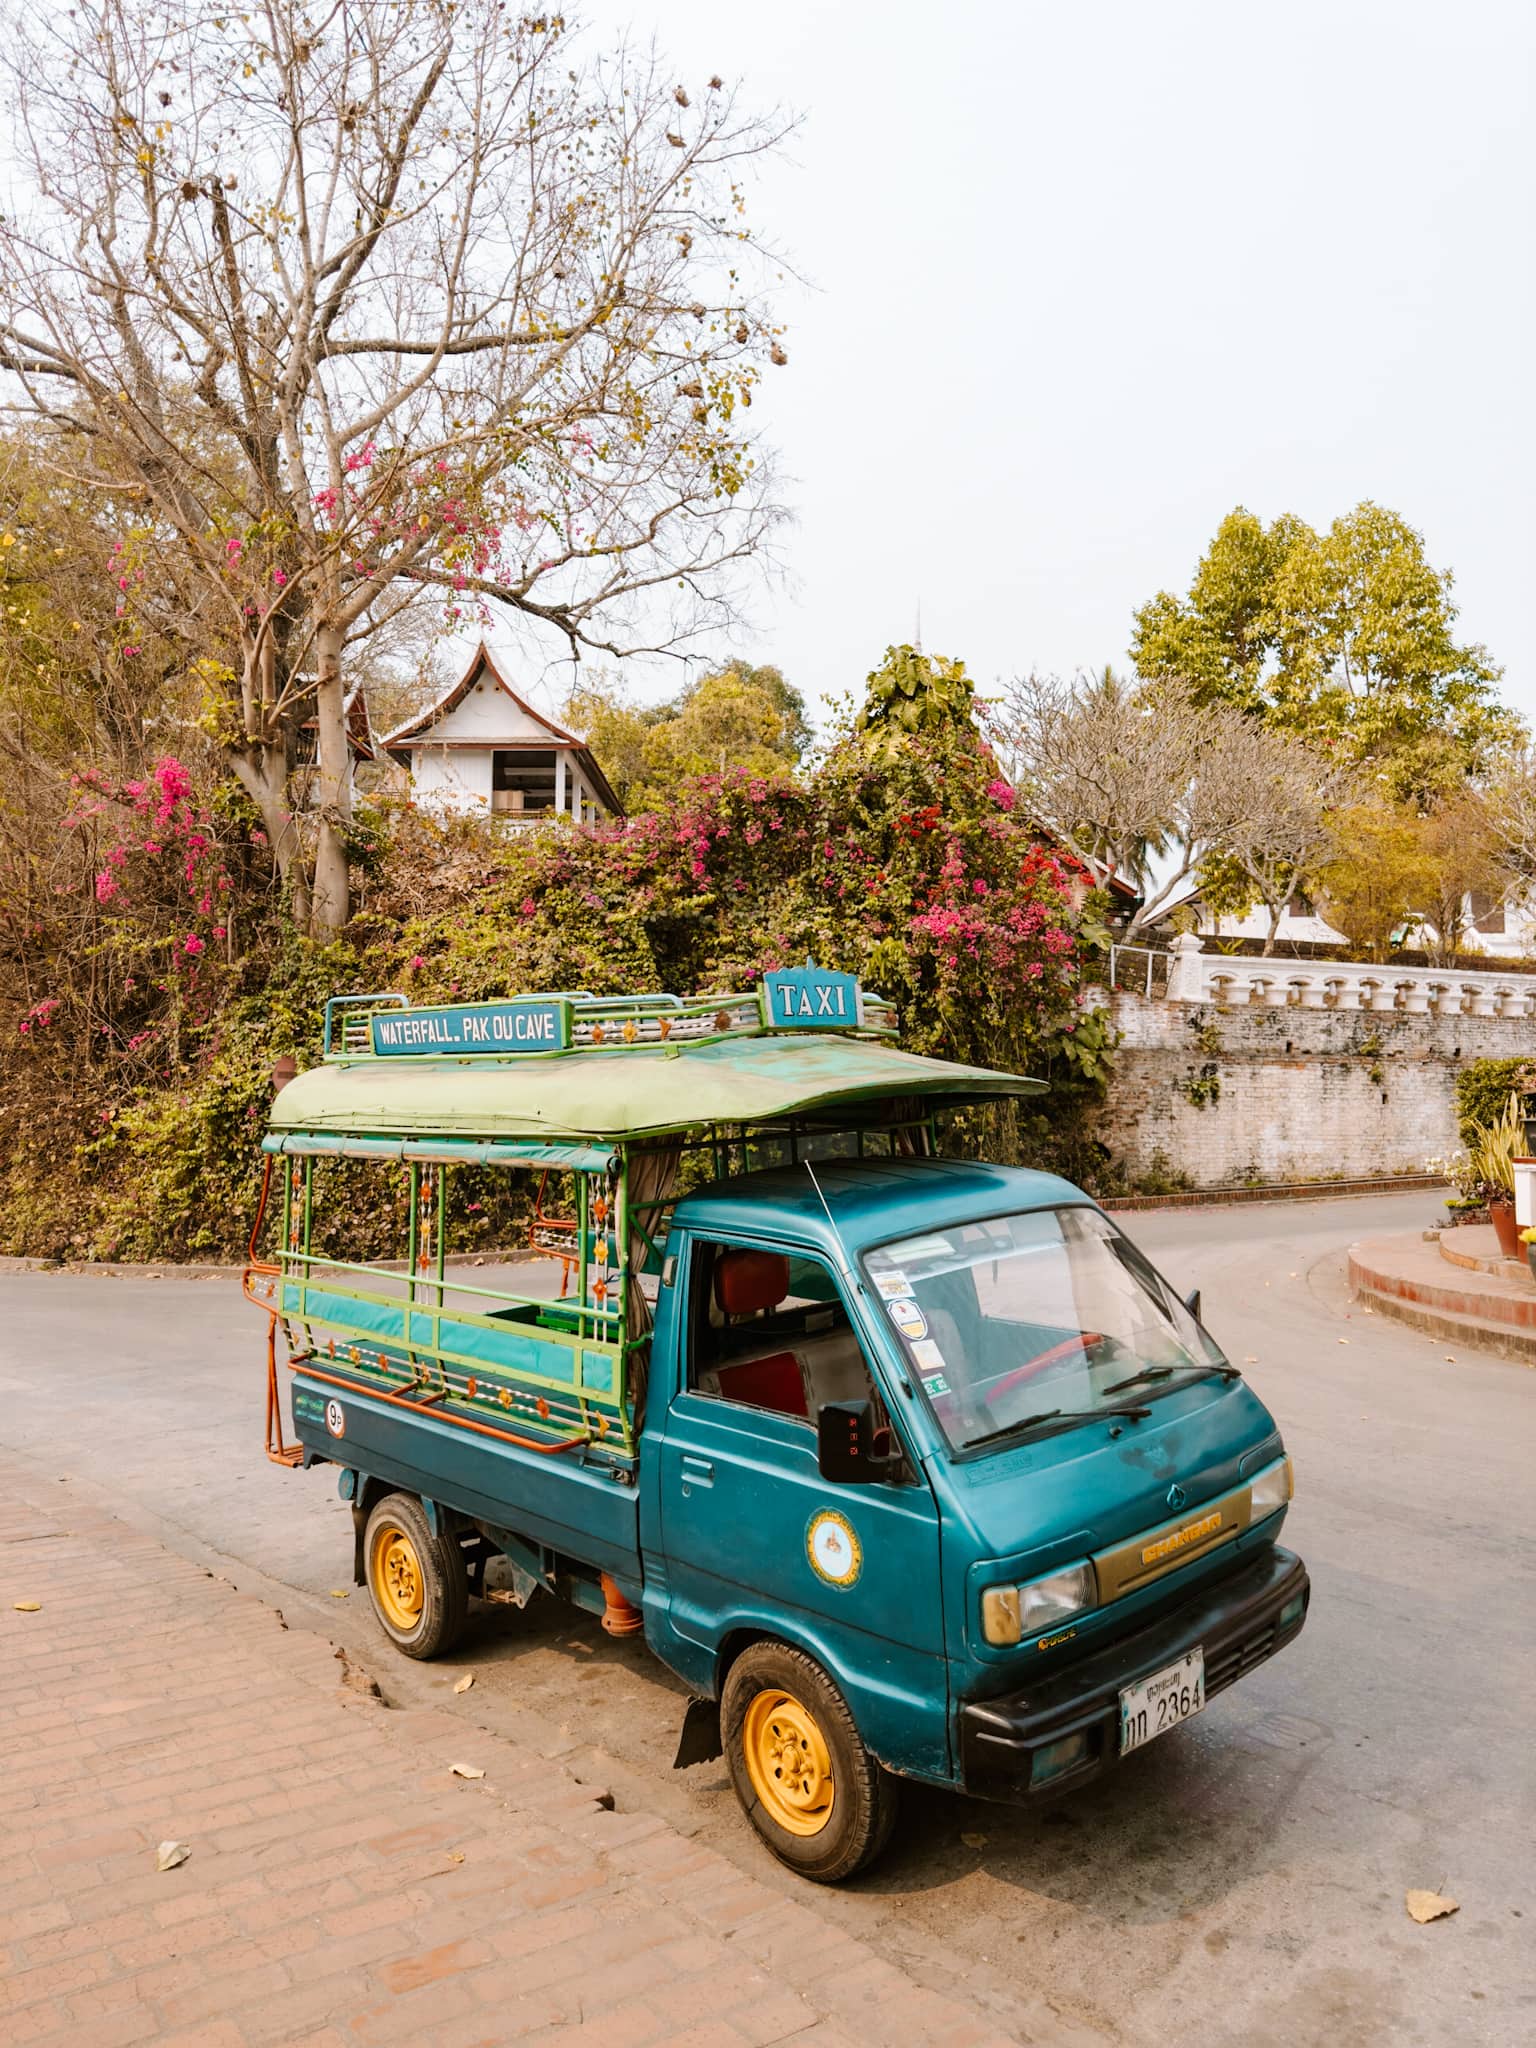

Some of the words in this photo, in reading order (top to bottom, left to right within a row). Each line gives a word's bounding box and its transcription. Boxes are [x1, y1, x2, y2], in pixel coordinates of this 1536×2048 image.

[777, 984, 847, 1017] TAXI
[463, 1016, 490, 1042] PAK
[493, 1015, 513, 1040] OU
[515, 1013, 555, 1040] CAVE
[1157, 1679, 1201, 1731] 2364
